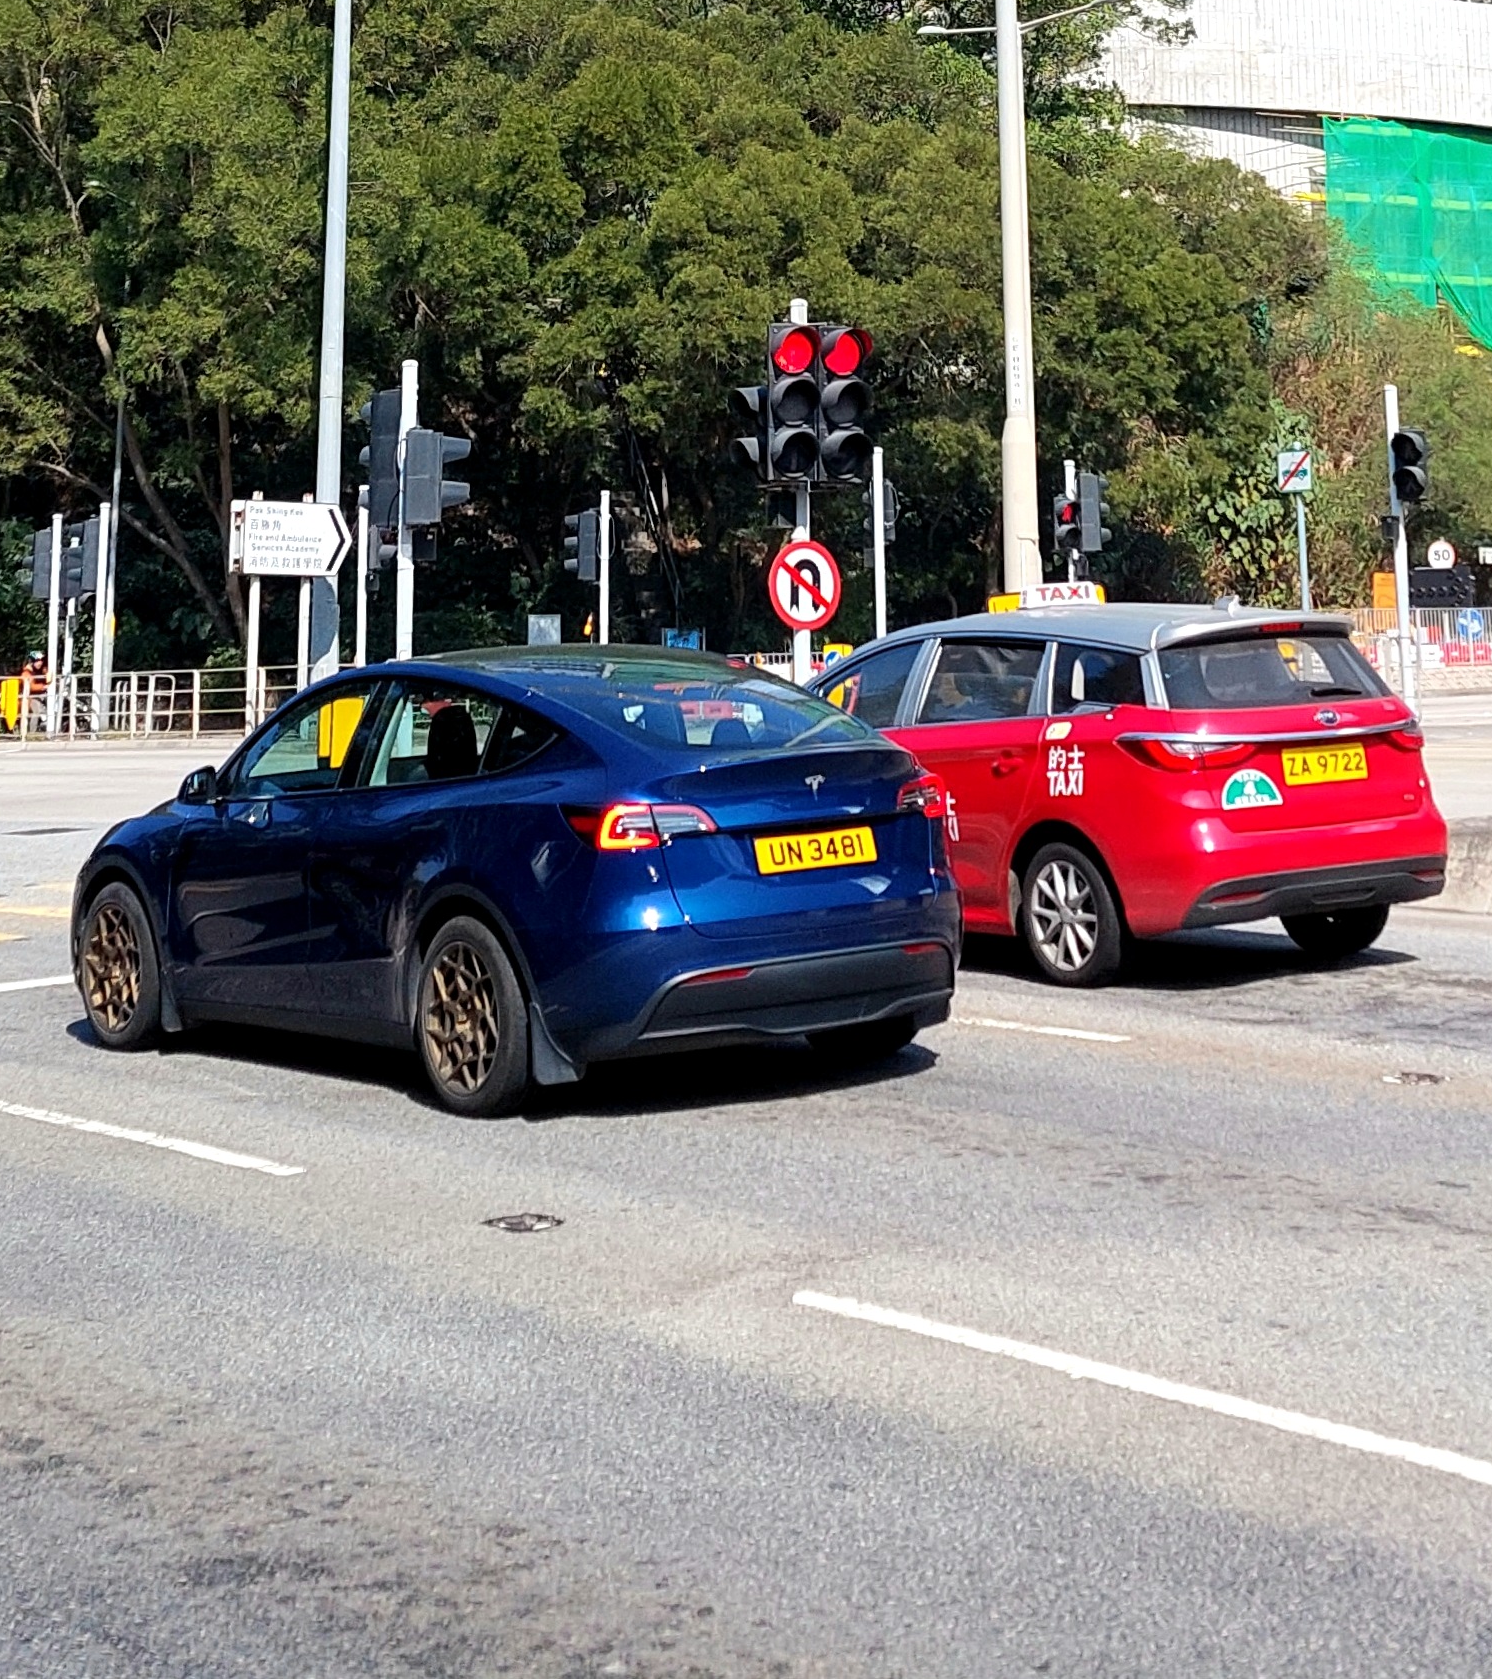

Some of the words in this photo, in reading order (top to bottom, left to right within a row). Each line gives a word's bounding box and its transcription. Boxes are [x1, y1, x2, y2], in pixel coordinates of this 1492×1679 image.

[249, 533, 263, 541] Fire
[265, 533, 279, 542] and
[281, 534, 322, 543] Ambulance
[251, 543, 283, 552] Services
[285, 544, 319, 554] Academy
[1433, 549, 1451, 561] 50
[249, 557, 323, 570] 消防及救護學院
[1036, 585, 1090, 602] TAXI
[1048, 744, 1085, 770] 的士
[1287, 757, 1312, 777] ZA
[1317, 752, 1364, 775] 9722
[1046, 769, 1084, 797] TAXI
[769, 840, 804, 866] UN
[808, 833, 865, 862] 3481
